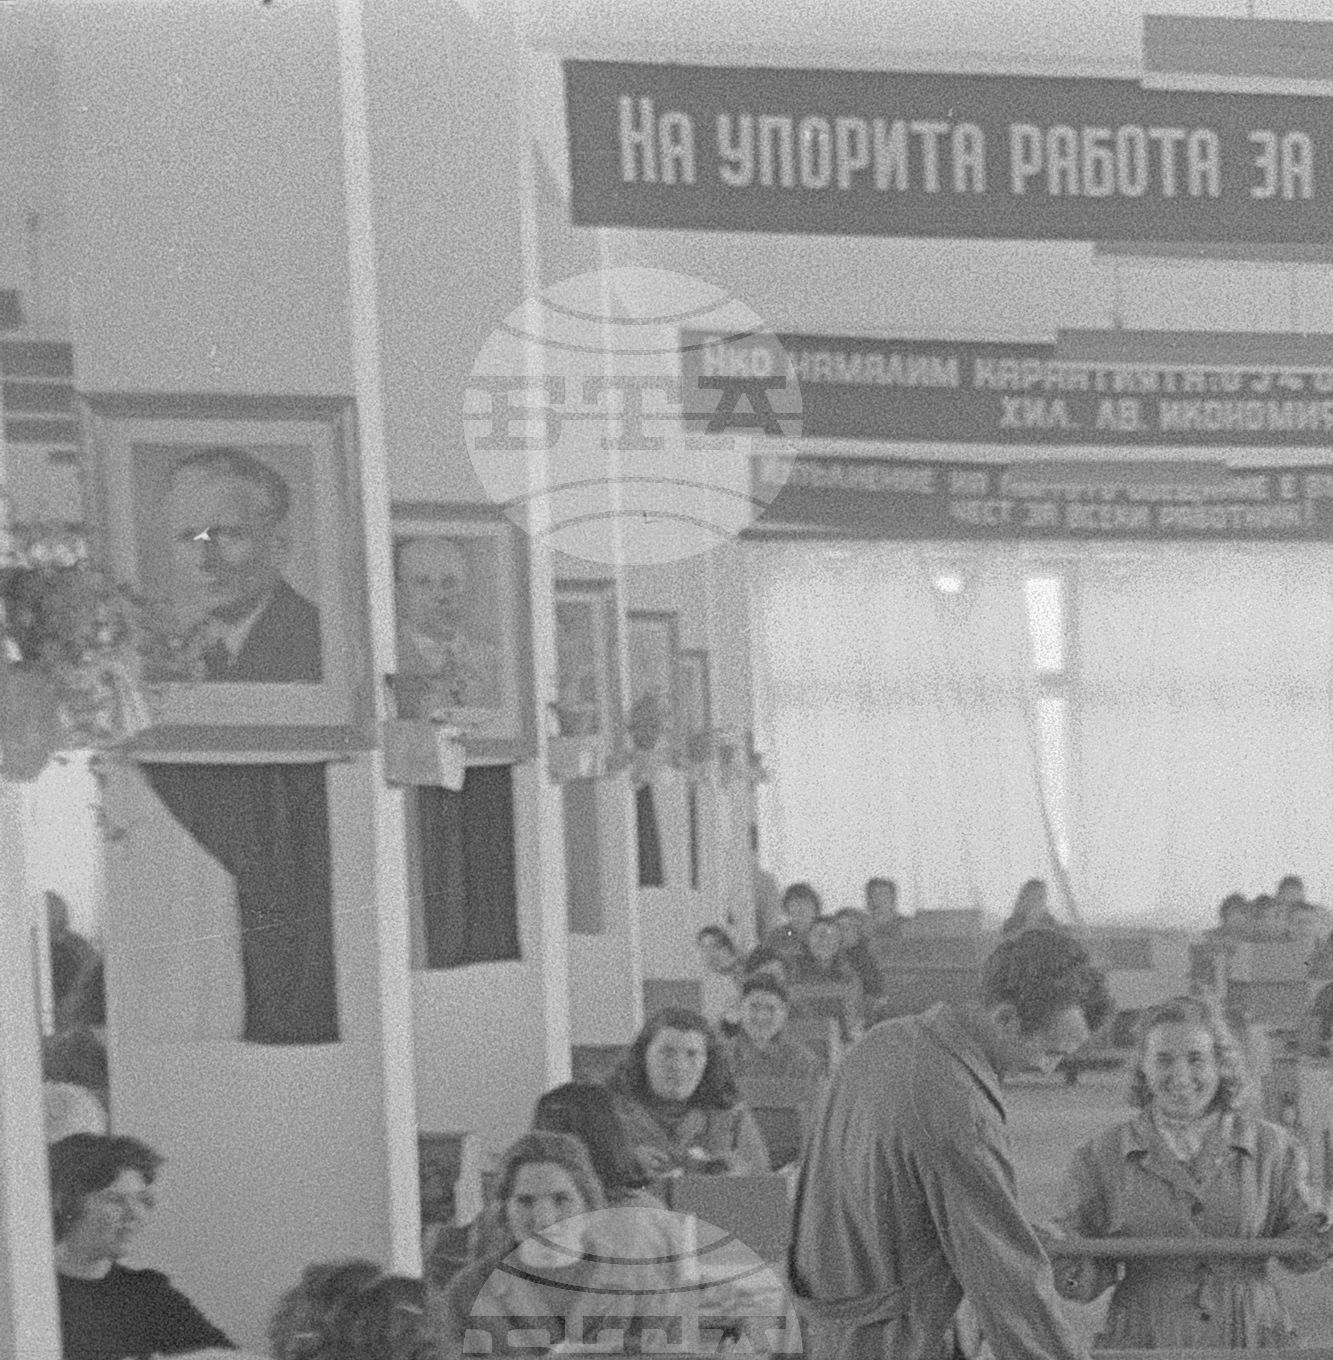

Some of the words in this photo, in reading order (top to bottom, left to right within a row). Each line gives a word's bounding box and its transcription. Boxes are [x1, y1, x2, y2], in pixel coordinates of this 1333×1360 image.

[717, 111, 987, 194] УПОРИТА
[1008, 123, 1221, 200] РАБОТА
[1247, 129, 1313, 200] ЗА
